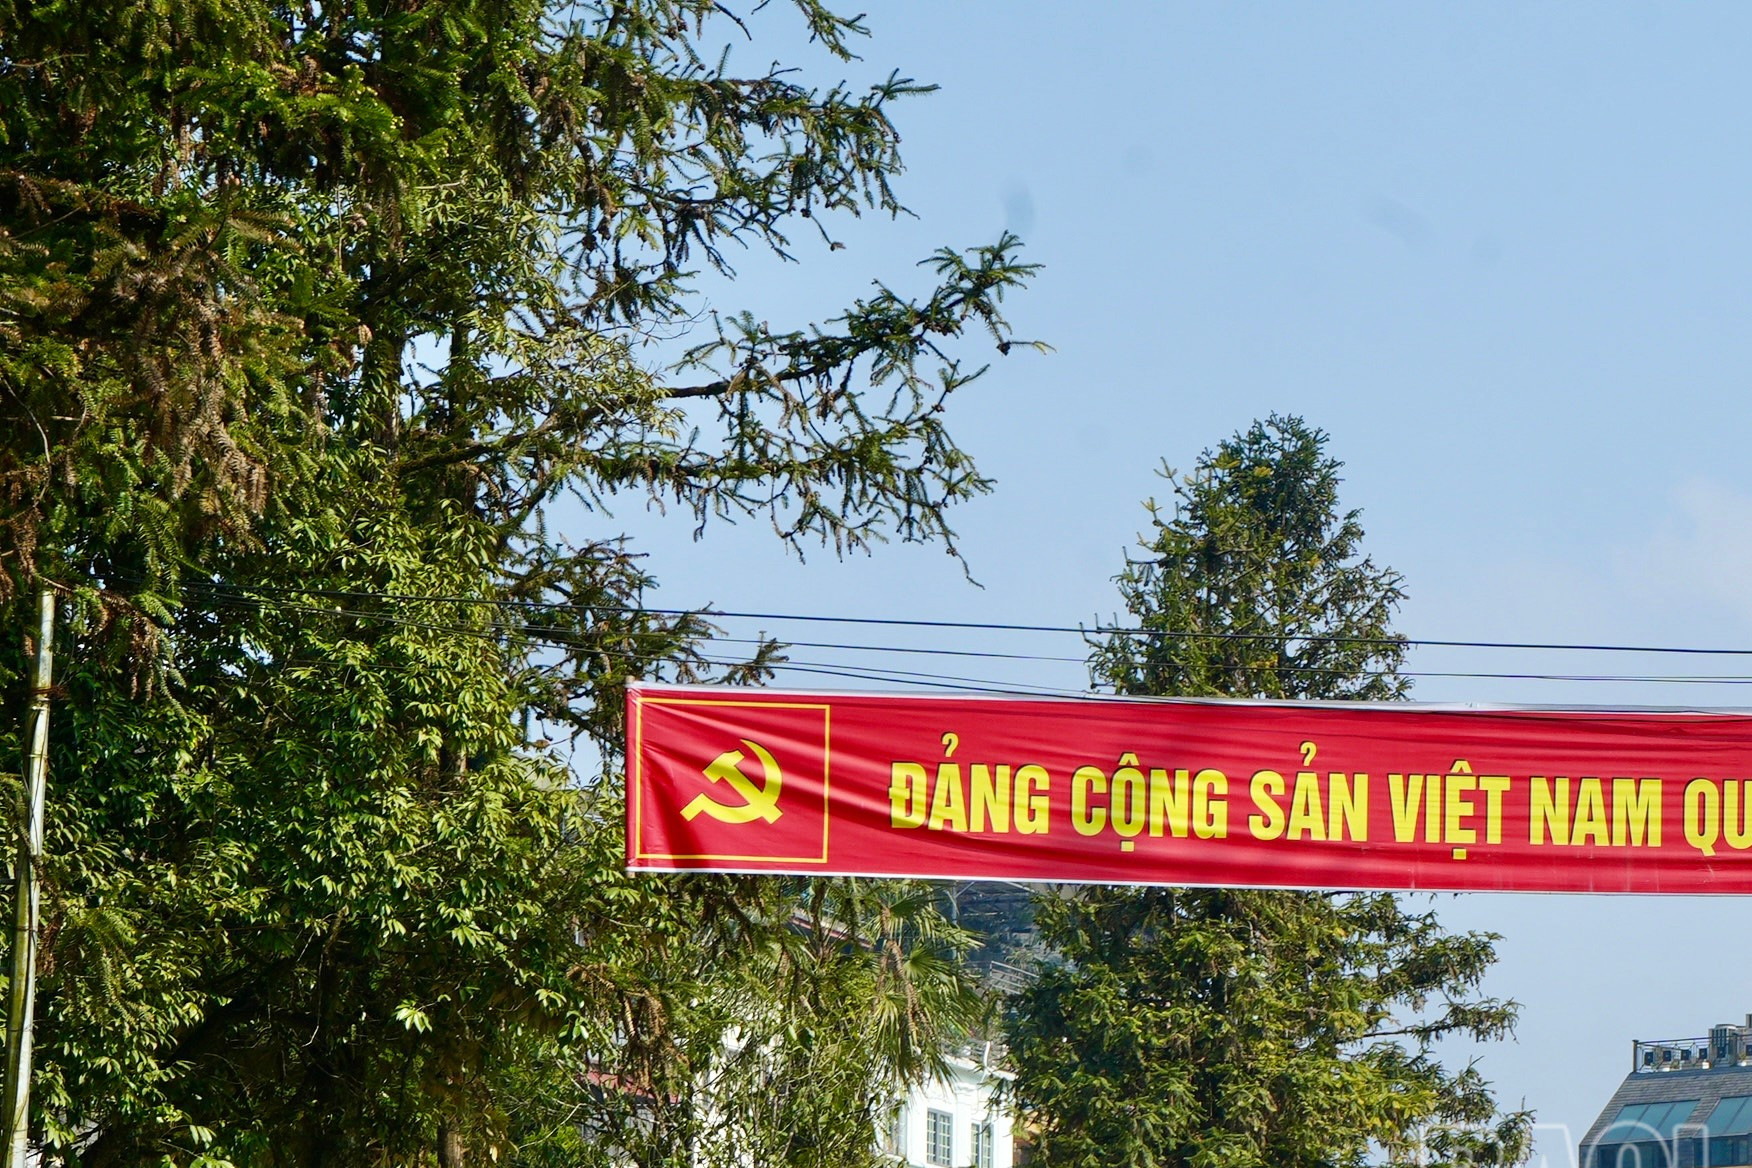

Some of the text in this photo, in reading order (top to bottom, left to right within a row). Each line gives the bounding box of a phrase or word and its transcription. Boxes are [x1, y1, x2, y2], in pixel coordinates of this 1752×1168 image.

[888, 732, 1051, 835] ĐẢNG
[1070, 752, 1229, 852] CỘNG
[1249, 741, 1369, 842] SẢN
[1388, 759, 1511, 860] VIỆT
[1529, 776, 1663, 848] NAM
